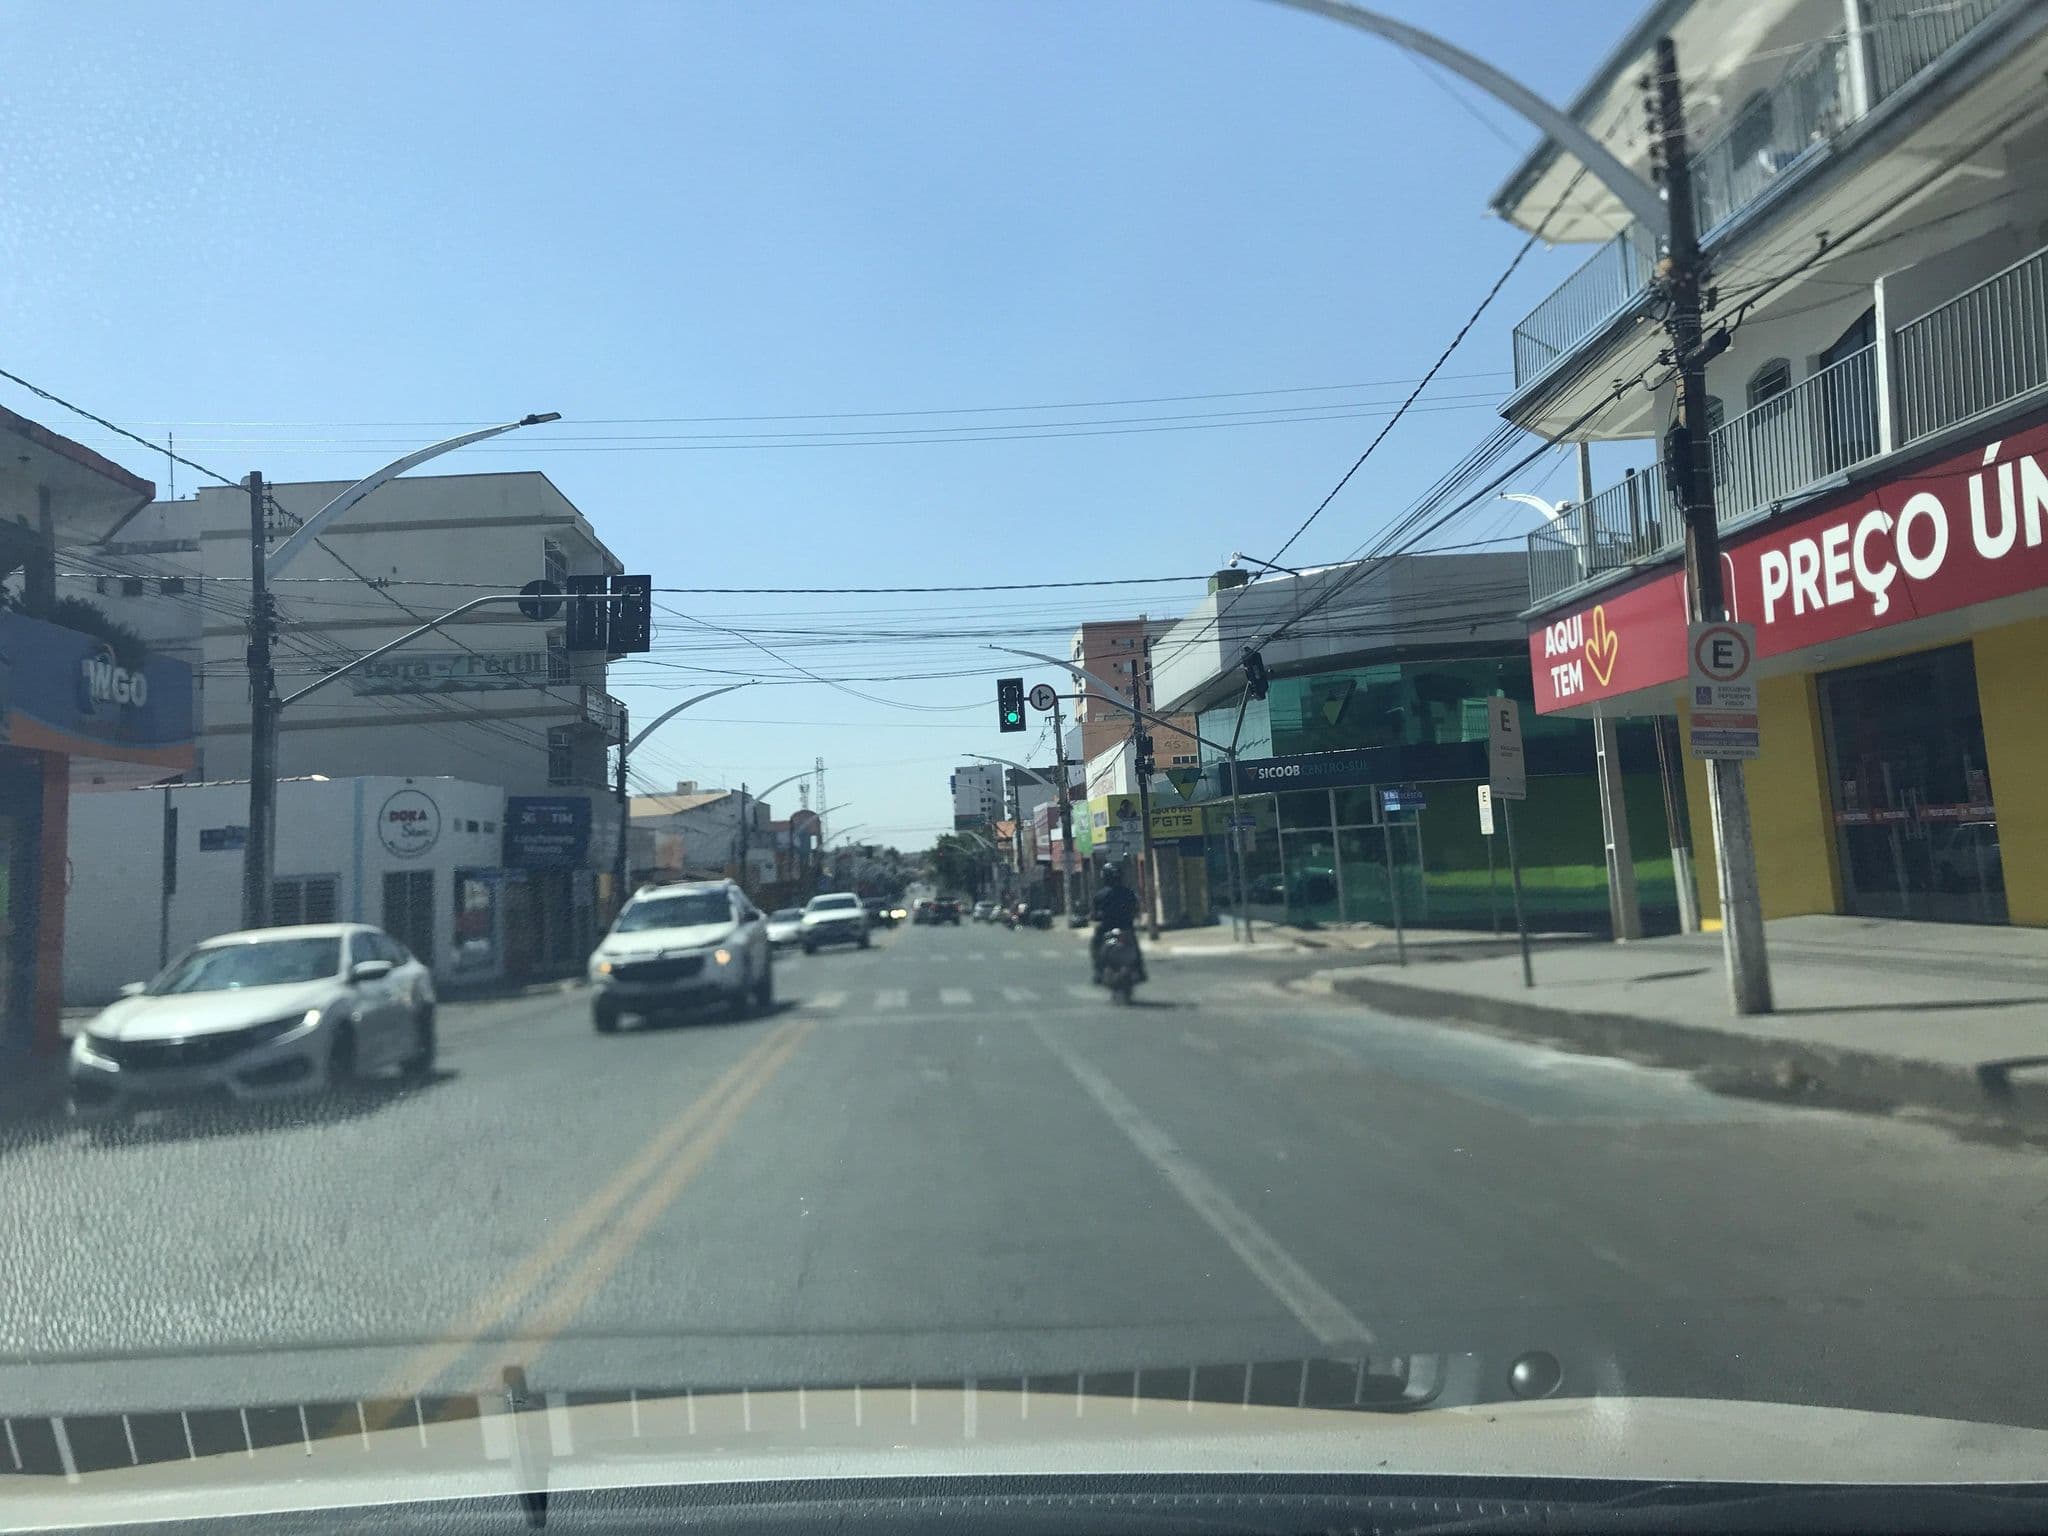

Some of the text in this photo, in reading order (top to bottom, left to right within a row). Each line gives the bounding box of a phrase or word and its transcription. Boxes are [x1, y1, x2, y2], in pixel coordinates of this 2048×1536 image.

[1760, 492, 1949, 624] PREÇO
[1545, 614, 1583, 658] AQUI
[1713, 640, 1734, 668] E
[1551, 660, 1583, 698] TEM
[1500, 710, 1512, 732] E
[1258, 765, 1300, 780] SICOOB
[1152, 815, 1193, 828] FGTS
